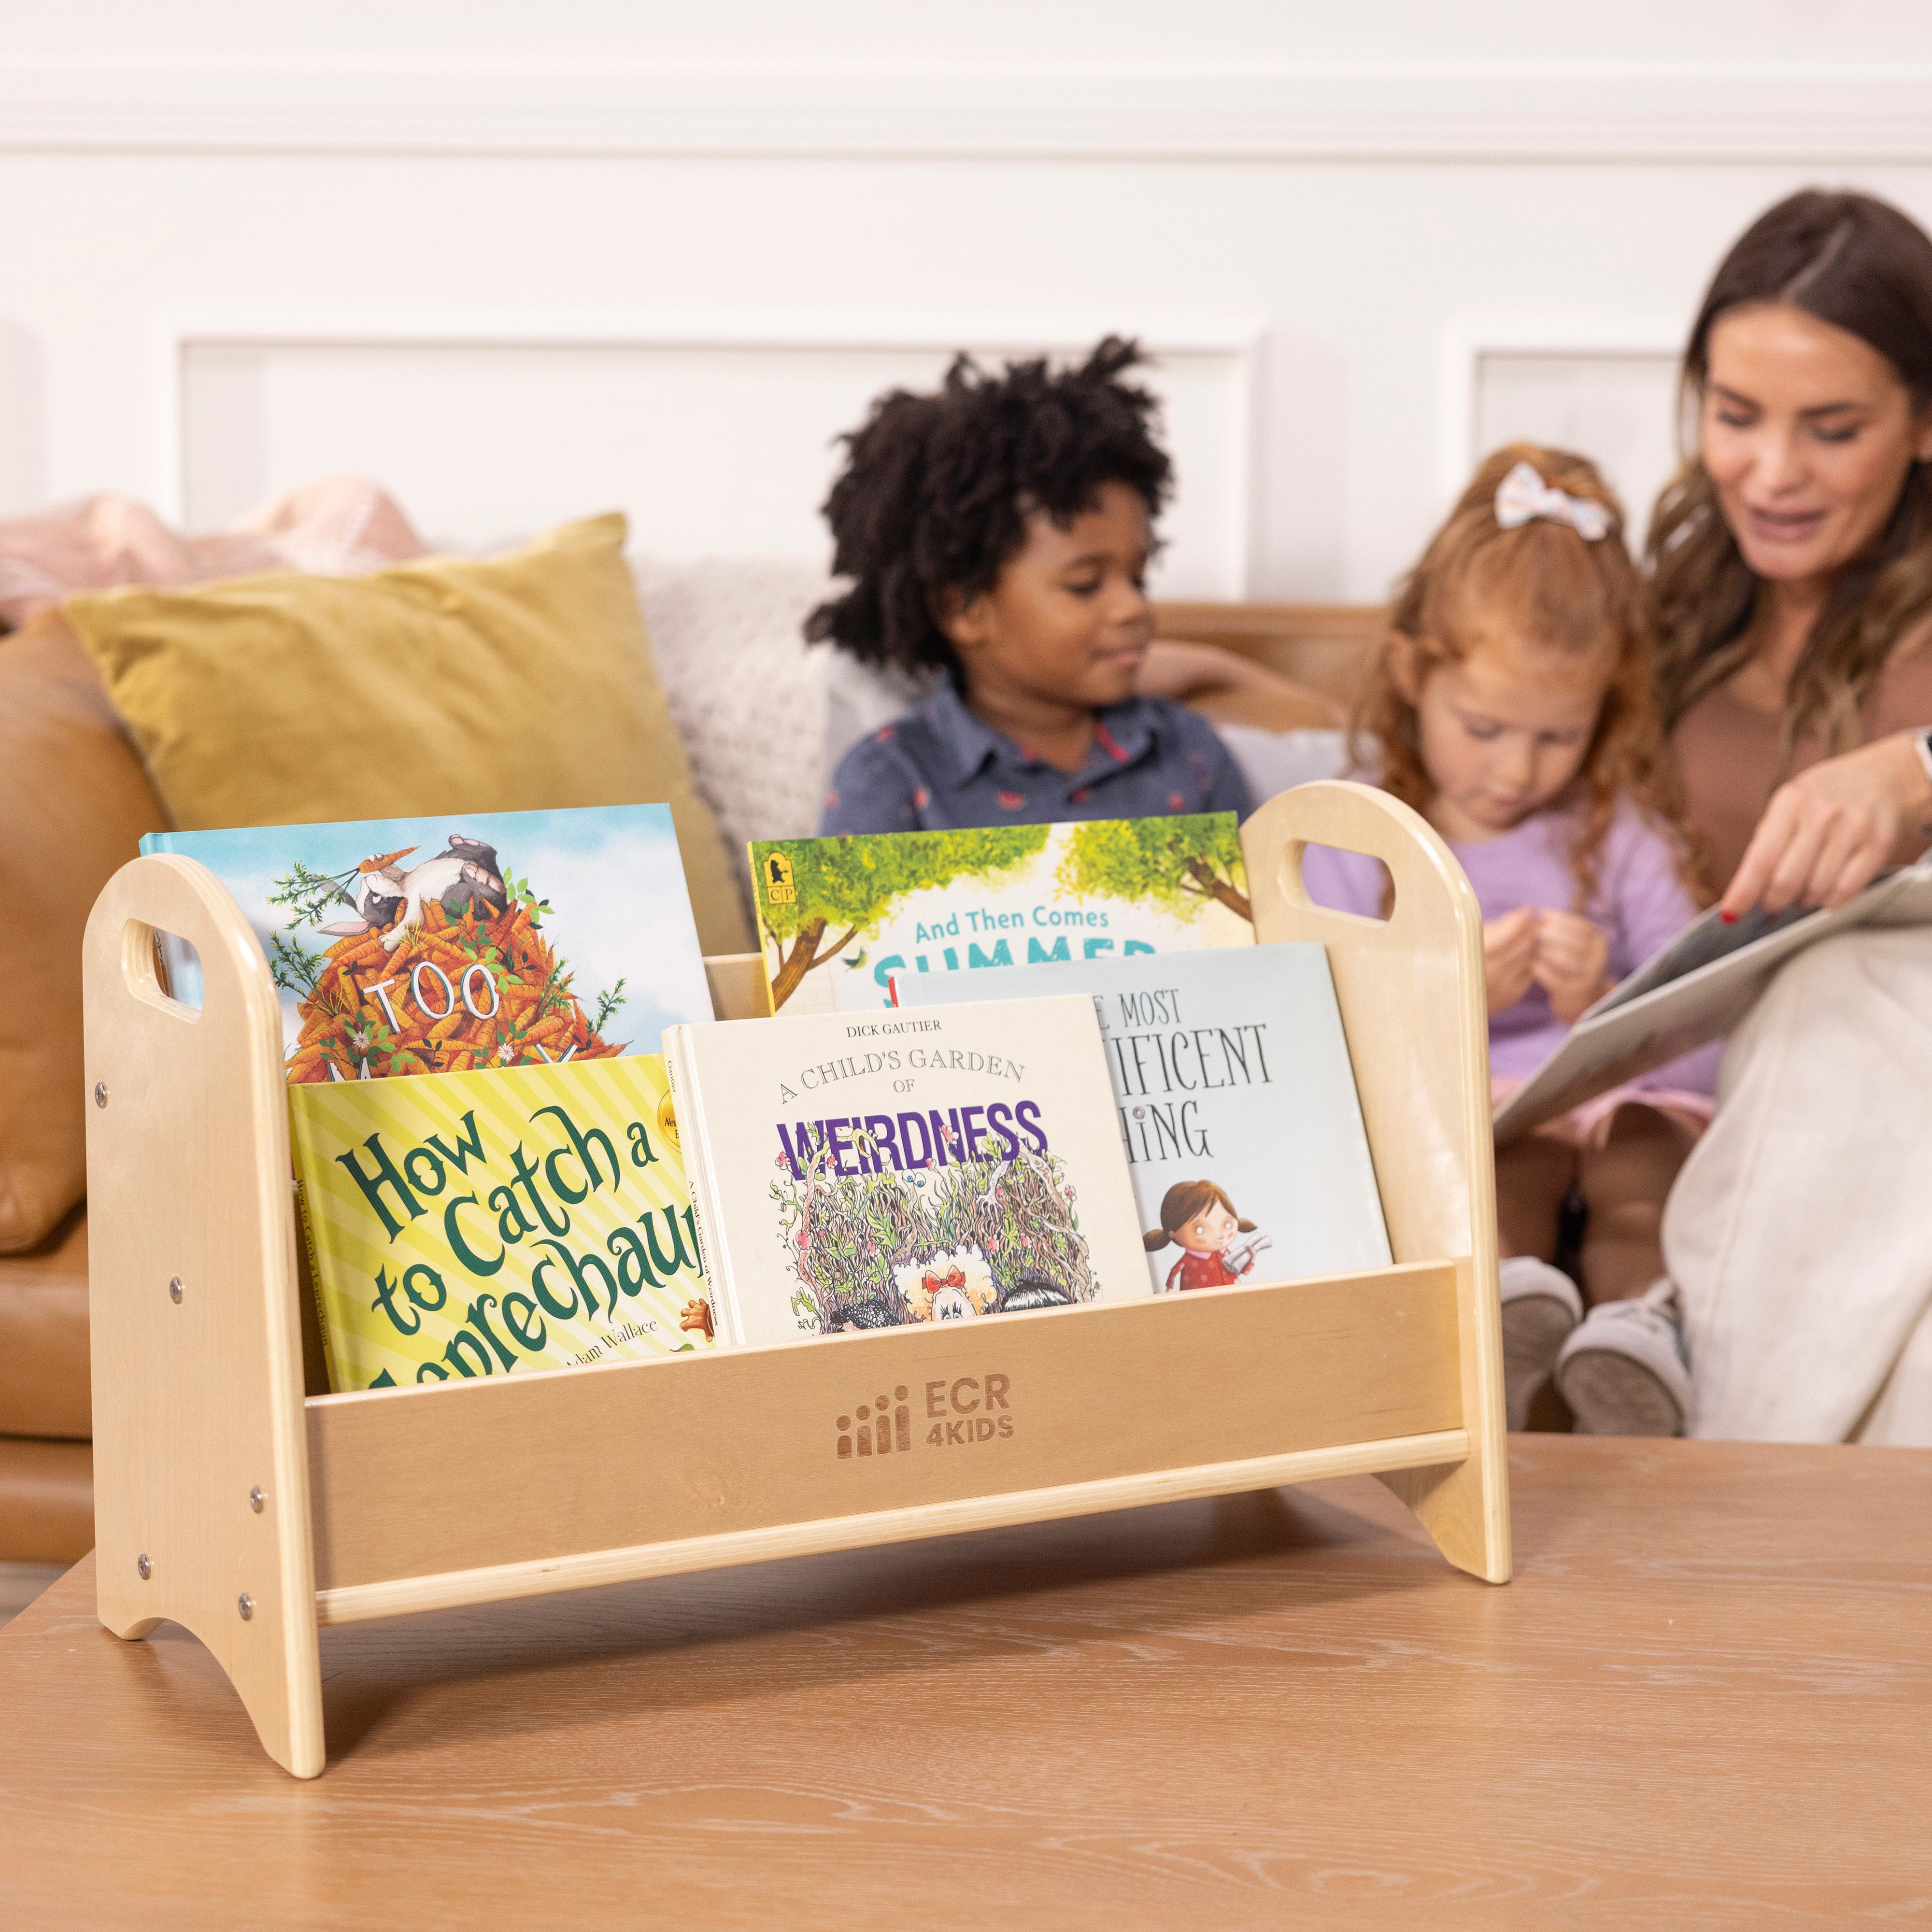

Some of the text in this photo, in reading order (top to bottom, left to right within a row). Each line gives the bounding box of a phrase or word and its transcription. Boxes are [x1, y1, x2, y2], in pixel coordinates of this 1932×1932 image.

[916, 906, 1108, 944] And Then Comes
[362, 961, 499, 1034] TOO
[1118, 989, 1181, 1028] MOST
[847, 1020, 942, 1037] DICK GAUTIER
[668, 1061, 676, 1093] Gautier
[780, 1049, 1025, 1105] A CHILD'S GARDEN
[1103, 1023, 1272, 1095] IFICENT
[893, 1079, 915, 1093] OF
[776, 1100, 1048, 1181] WEIRDNESS
[336, 1110, 487, 1244] How
[303, 1210, 307, 1222] to
[306, 1226, 315, 1260] Catch
[372, 1106, 659, 1335] to Catch a
[689, 1181, 718, 1326] A Child's Garden of Weirdness
[567, 1321, 658, 1365] dam Wallace
[925, 1373, 1010, 1418] ECR
[926, 1415, 1014, 1447] 4KIDS
